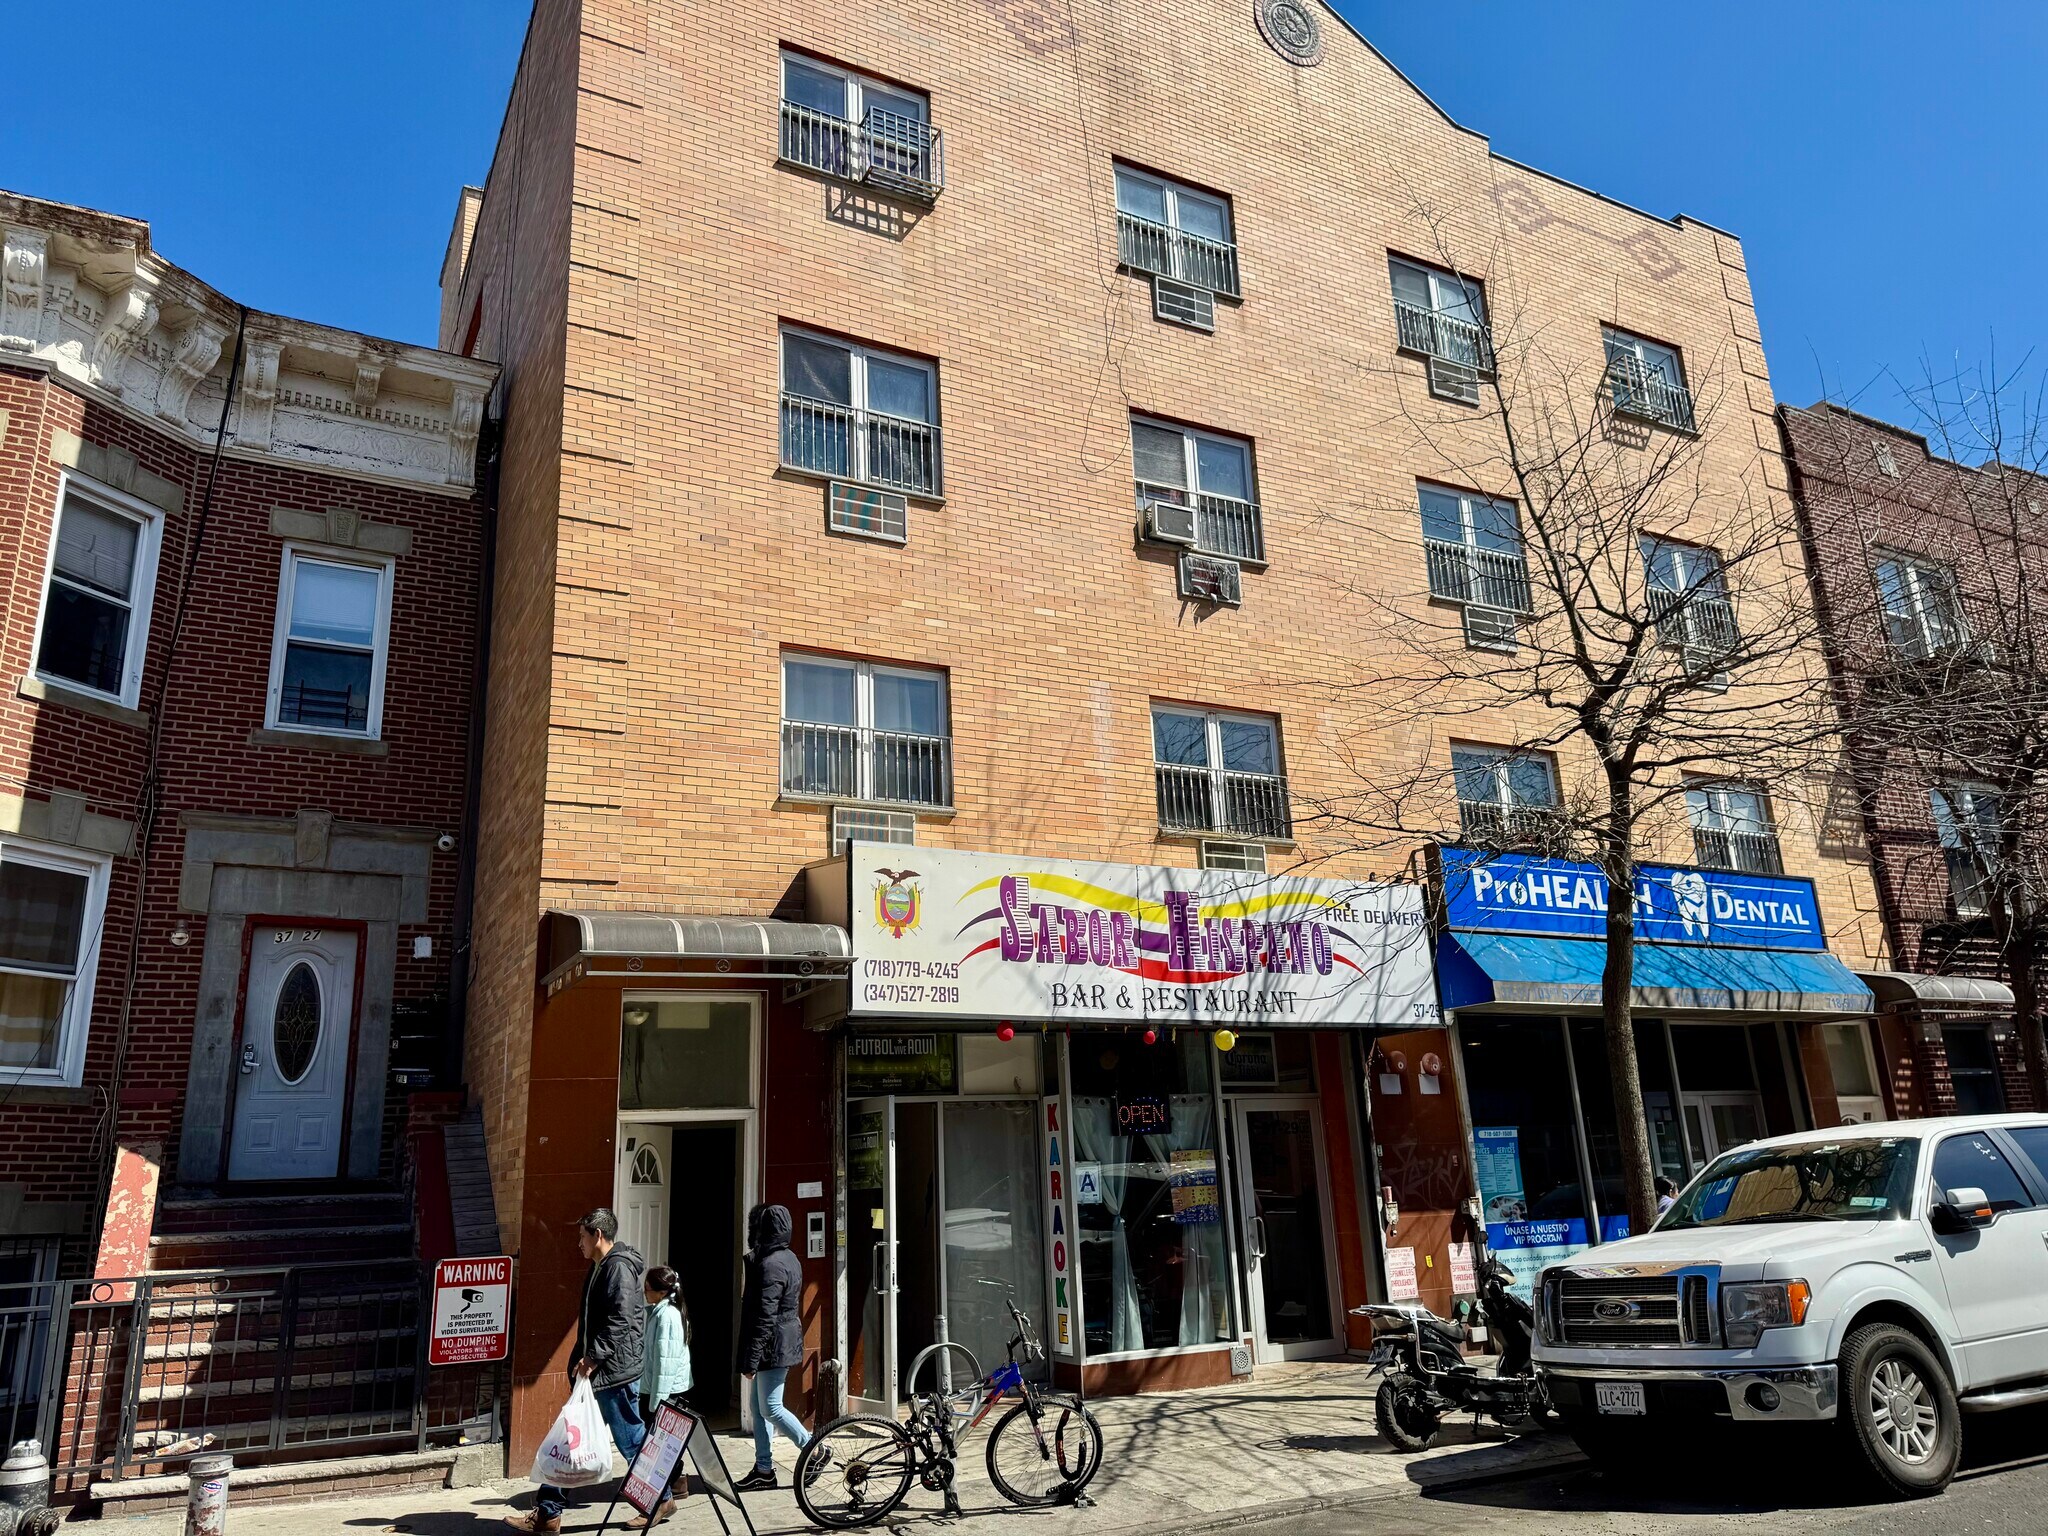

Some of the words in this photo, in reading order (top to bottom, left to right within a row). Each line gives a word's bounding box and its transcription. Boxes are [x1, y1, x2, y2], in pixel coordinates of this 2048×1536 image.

[1472, 868, 1655, 915] ProHEALH
[1711, 888, 1810, 925] DENTAL
[1326, 908, 1358, 923] FREE
[1364, 910, 1426, 926] DELIVERY
[1000, 875, 1138, 969] SABOR
[1164, 891, 1333, 976] HISPANO
[864, 960, 959, 979] (718)779-4245
[864, 984, 959, 1003] (347)527-2819
[1051, 983, 1108, 1010] BAR
[1116, 985, 1133, 1009] &
[1142, 987, 1297, 1014] RESTAURANT
[855, 1038, 894, 1055] FUTBOL
[908, 1038, 932, 1055] AQUI
[1119, 1104, 1164, 1123] OPEN
[1080, 1171, 1096, 1192] A
[1047, 1103, 1068, 1344] KARAOKE
[1504, 1224, 1530, 1236] ÚNASE
[1530, 1224, 1537, 1235] A
[1536, 1223, 1569, 1234] NUESTRO
[1513, 1236, 1526, 1245] VIP
[1527, 1233, 1563, 1244] PROGRAM
[1522, 1254, 1542, 1262] cuidado
[443, 1262, 505, 1284] WARNING
[1389, 1268, 1414, 1278] SPRINKLERS
[1393, 1288, 1416, 1297] BUILDING
[1455, 1283, 1475, 1291] BUILDIN
[464, 1311, 493, 1320] PROPERTY
[1601, 1305, 1619, 1315] Ford
[454, 1319, 486, 1327] PROTECTED
[458, 1325, 499, 1335] SURVEILLANCE
[441, 1338, 454, 1349] NO
[457, 1335, 497, 1347] DUMPING
[439, 1348, 473, 1356] VIOLATORS
[448, 1352, 488, 1361] PROSECUTED
[1599, 1391, 1615, 1406] LLC
[1620, 1391, 1639, 1407] 2727
